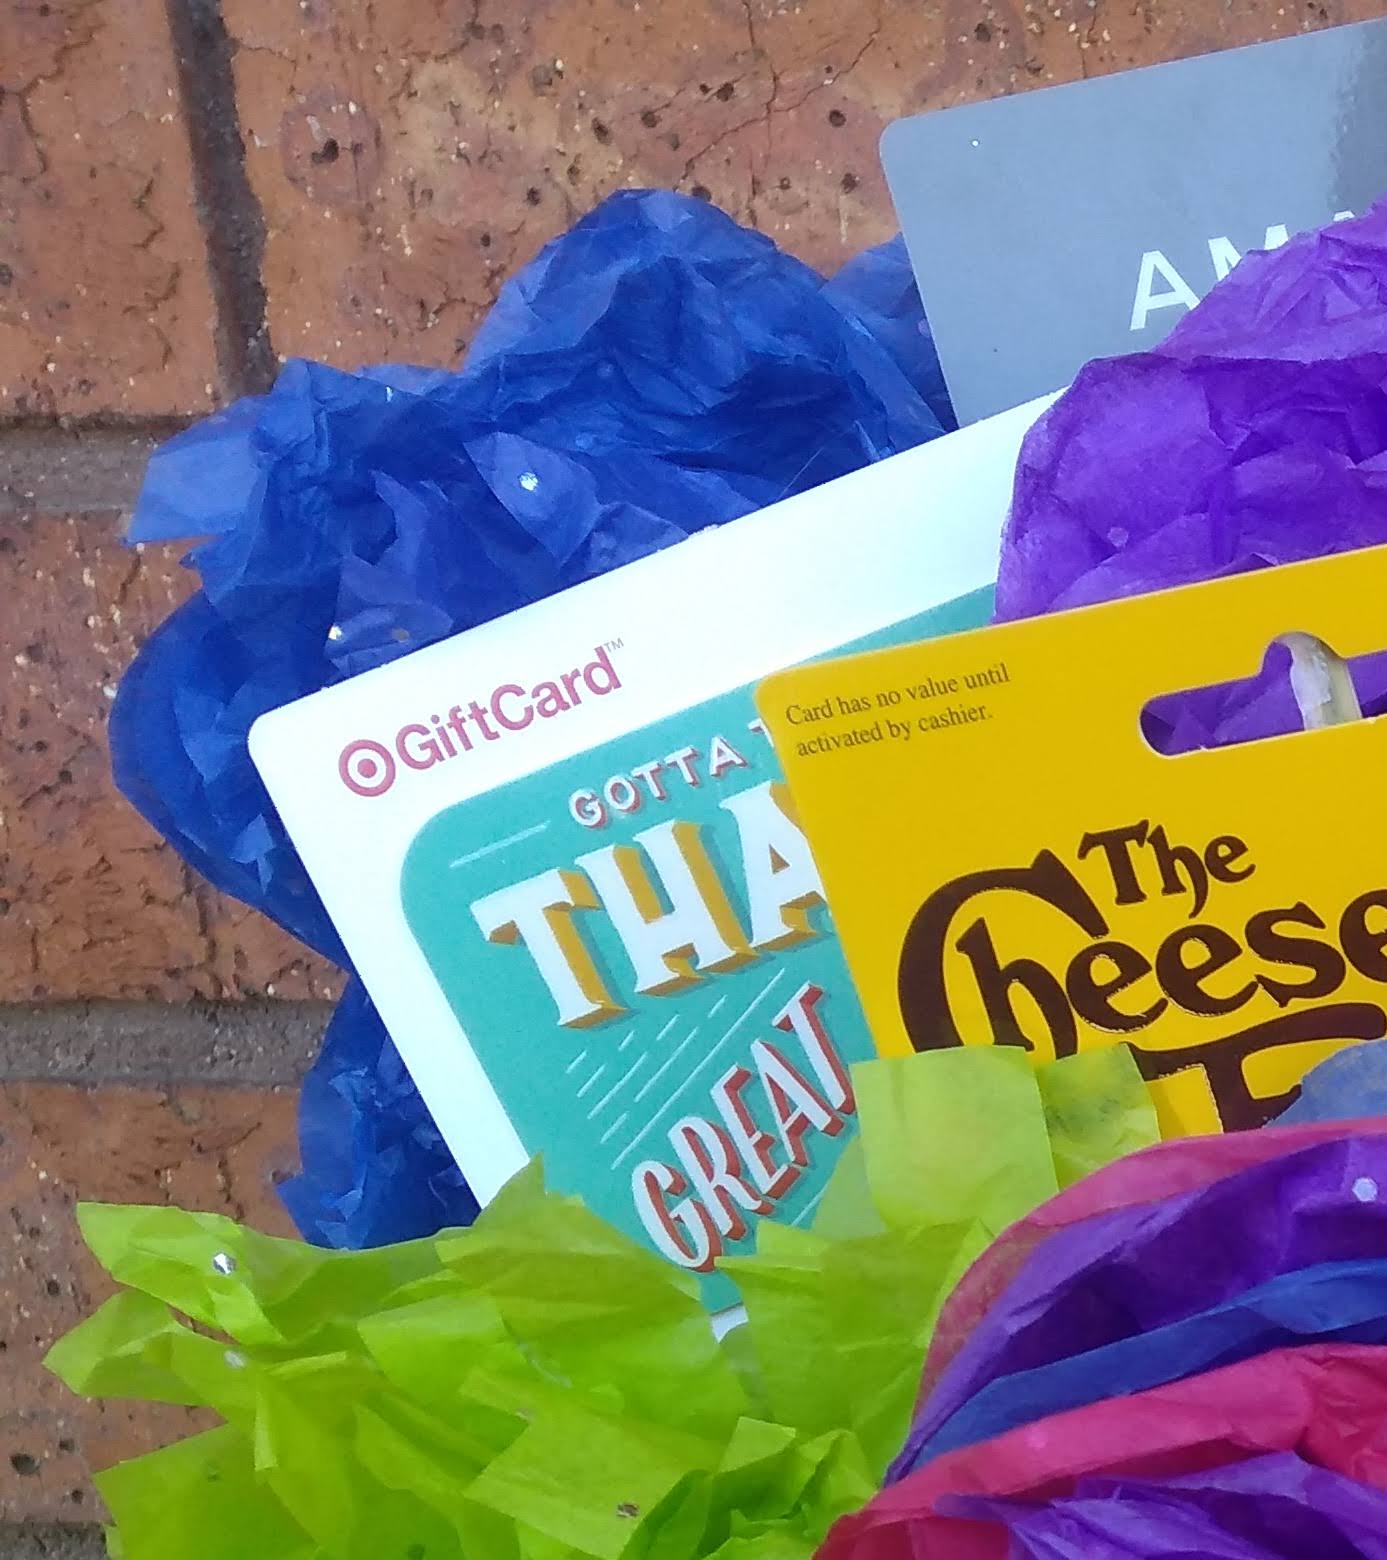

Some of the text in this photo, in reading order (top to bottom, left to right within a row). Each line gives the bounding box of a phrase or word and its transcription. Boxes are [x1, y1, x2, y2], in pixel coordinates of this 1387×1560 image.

[785, 662, 1011, 725] Card has no value until
[797, 722, 883, 757] activated
[887, 719, 912, 741] by
[918, 704, 993, 732] cashier.
[568, 735, 748, 830] GOTTA
[1077, 818, 1256, 919] The
[632, 979, 858, 1273] GREAT
